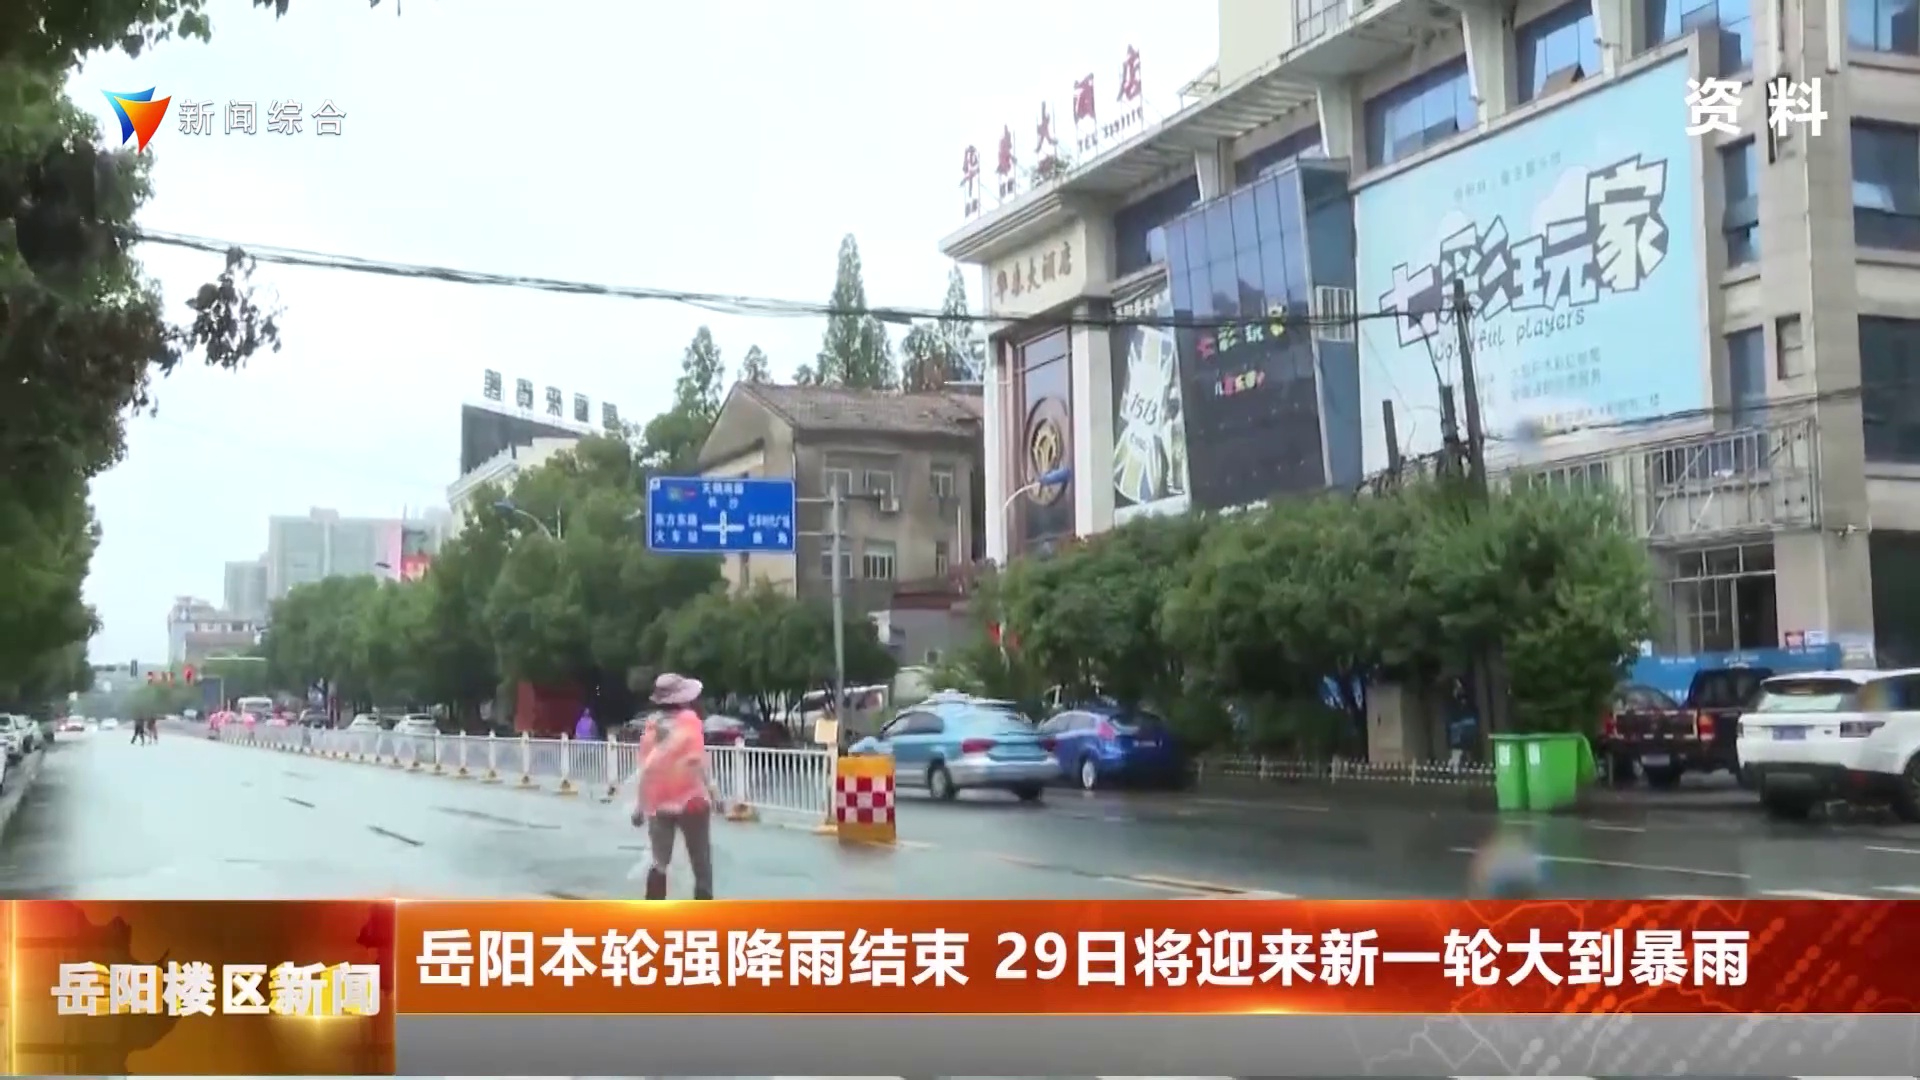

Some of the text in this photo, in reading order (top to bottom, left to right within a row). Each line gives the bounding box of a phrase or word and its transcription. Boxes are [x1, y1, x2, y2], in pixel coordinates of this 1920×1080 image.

[994, 240, 1072, 304] 华泰大酒店
[1378, 152, 1670, 349] 七彩玩家
[1515, 308, 1586, 347] players
